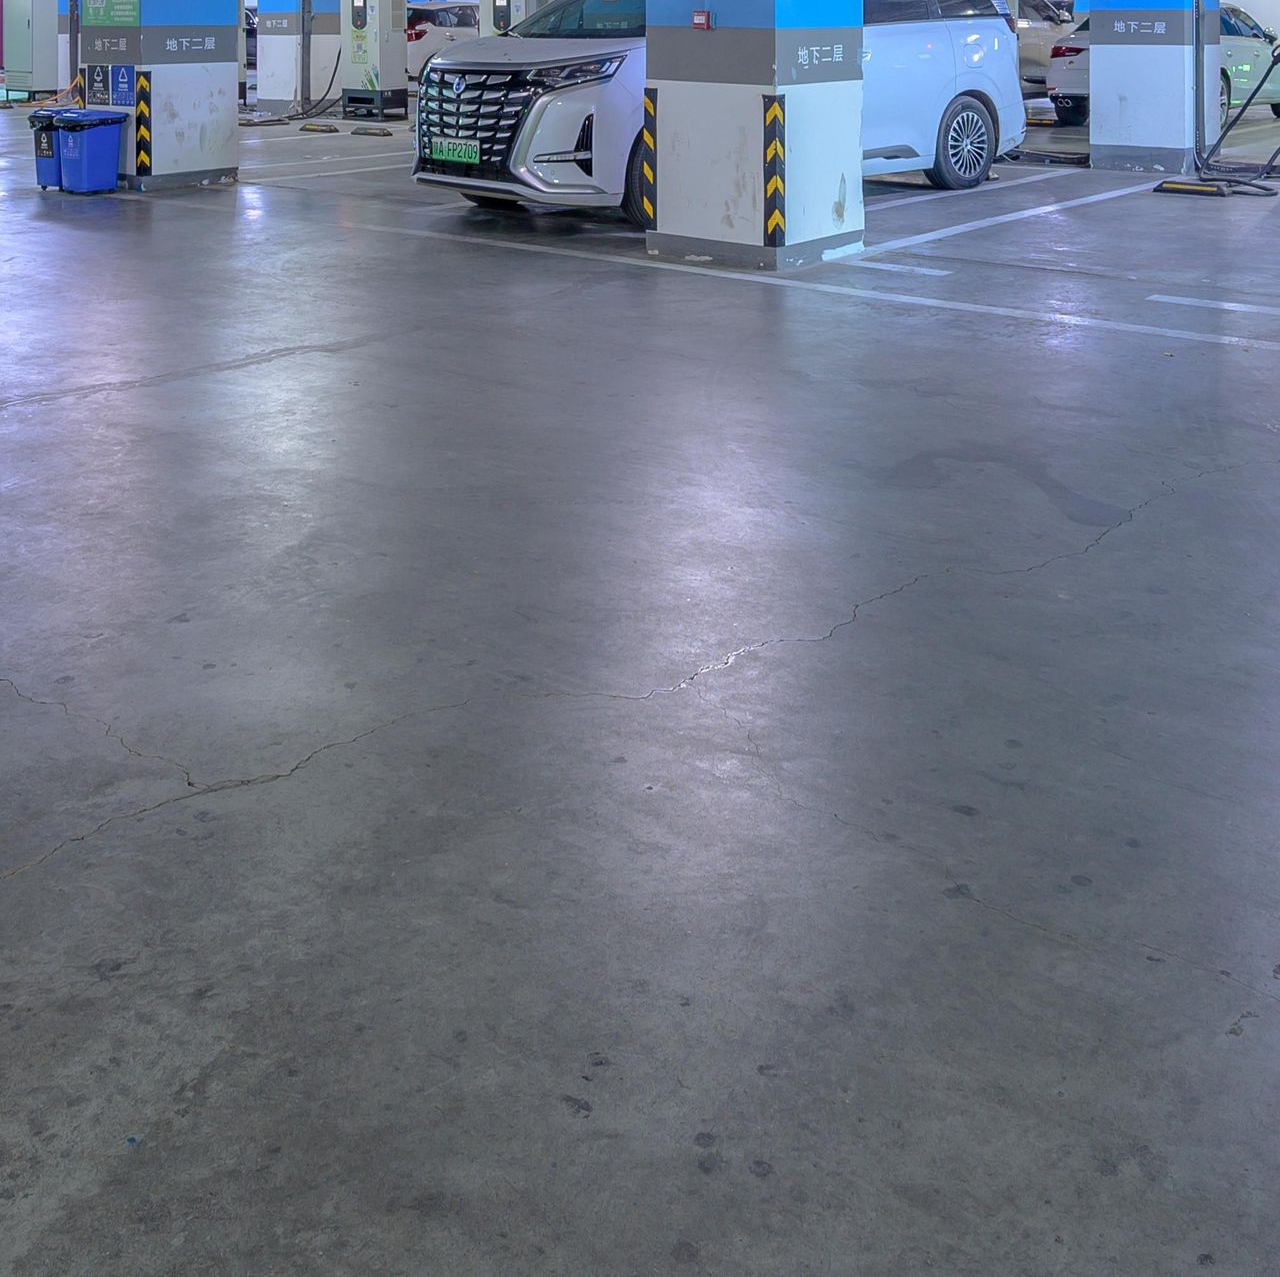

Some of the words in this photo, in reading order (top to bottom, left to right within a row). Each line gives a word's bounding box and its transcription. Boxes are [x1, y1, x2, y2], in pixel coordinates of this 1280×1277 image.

[1113, 20, 1166, 34] 地下二层
[166, 37, 215, 51] 地下二层
[797, 44, 843, 68] 地下二层
